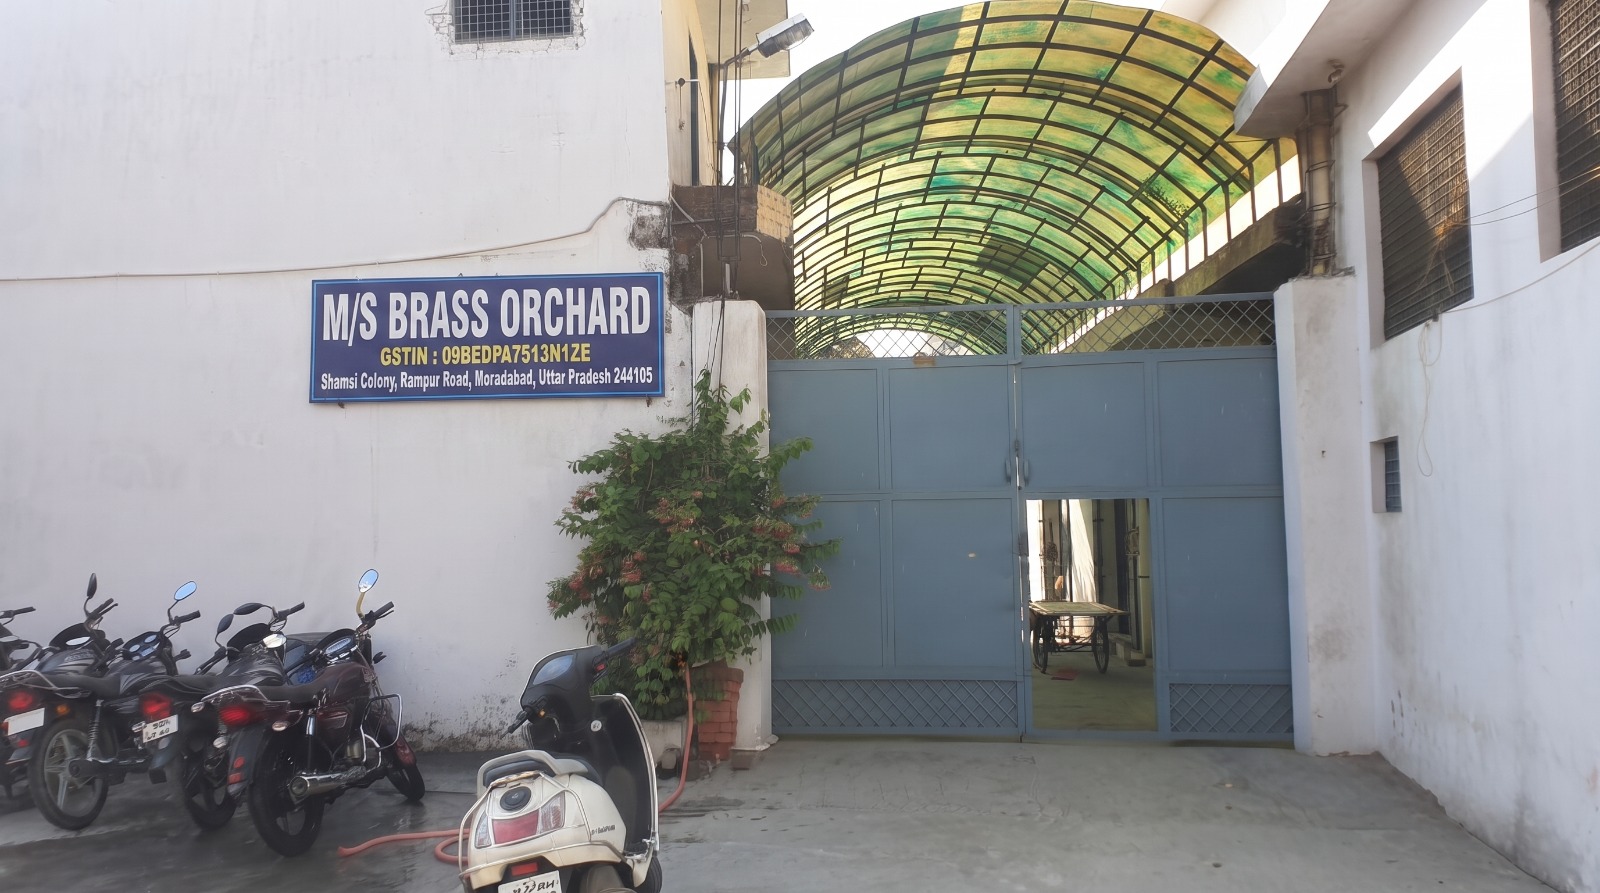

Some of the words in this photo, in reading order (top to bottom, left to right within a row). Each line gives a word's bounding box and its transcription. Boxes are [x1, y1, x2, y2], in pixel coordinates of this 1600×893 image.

[323, 292, 377, 346] M/S
[389, 289, 489, 339] BRASS
[500, 286, 651, 337] ORCHARD
[380, 346, 428, 366] GSTIN
[442, 343, 591, 365] 09BEDPA7513N1ZE
[321, 373, 358, 390] Shamsi
[360, 372, 398, 393] Colony,
[400, 371, 440, 392] Rampur
[443, 370, 472, 391] Road,
[474, 369, 536, 389] Moradabad,
[538, 368, 566, 386] Uttar
[568, 367, 611, 385] Pradesh
[613, 366, 653, 384] 244105
